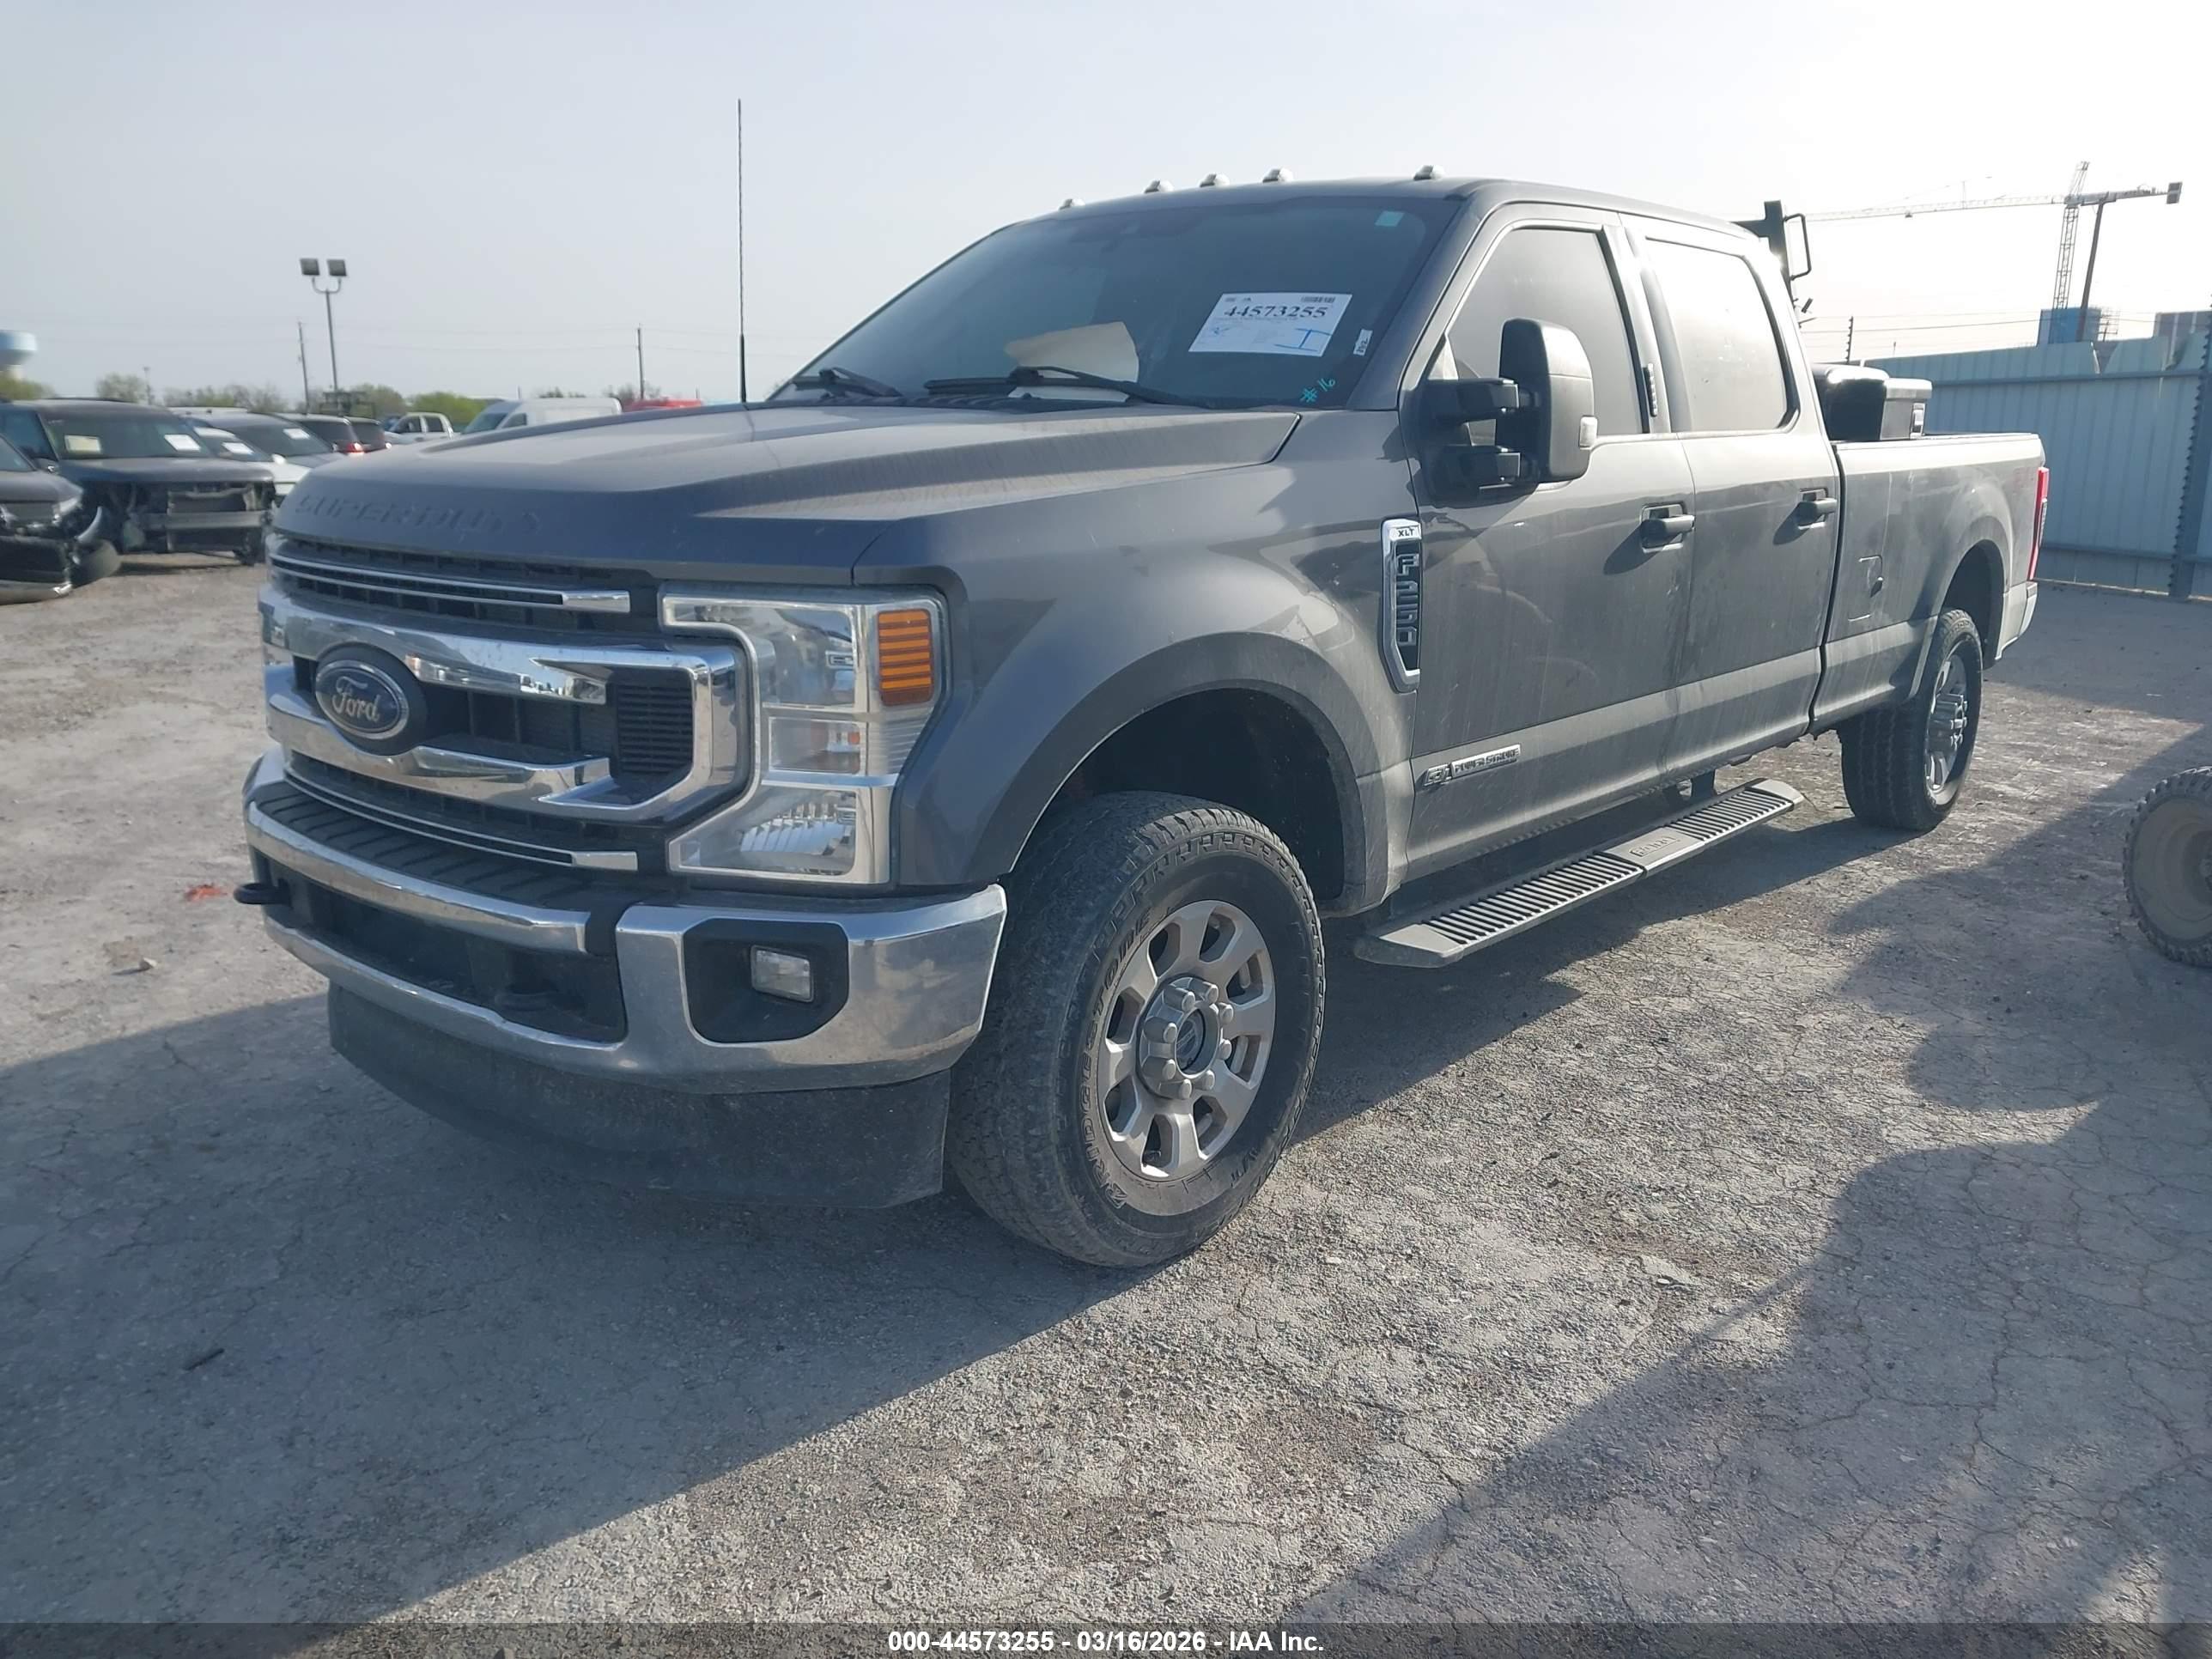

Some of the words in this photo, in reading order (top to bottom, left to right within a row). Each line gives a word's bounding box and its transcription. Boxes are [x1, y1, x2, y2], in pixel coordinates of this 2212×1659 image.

[1224, 305, 1328, 319] 44573255
[1397, 528, 1415, 538] XLT
[331, 676, 381, 722] Ford
[1078, 906, 1152, 1209] BRIDGESTONE
